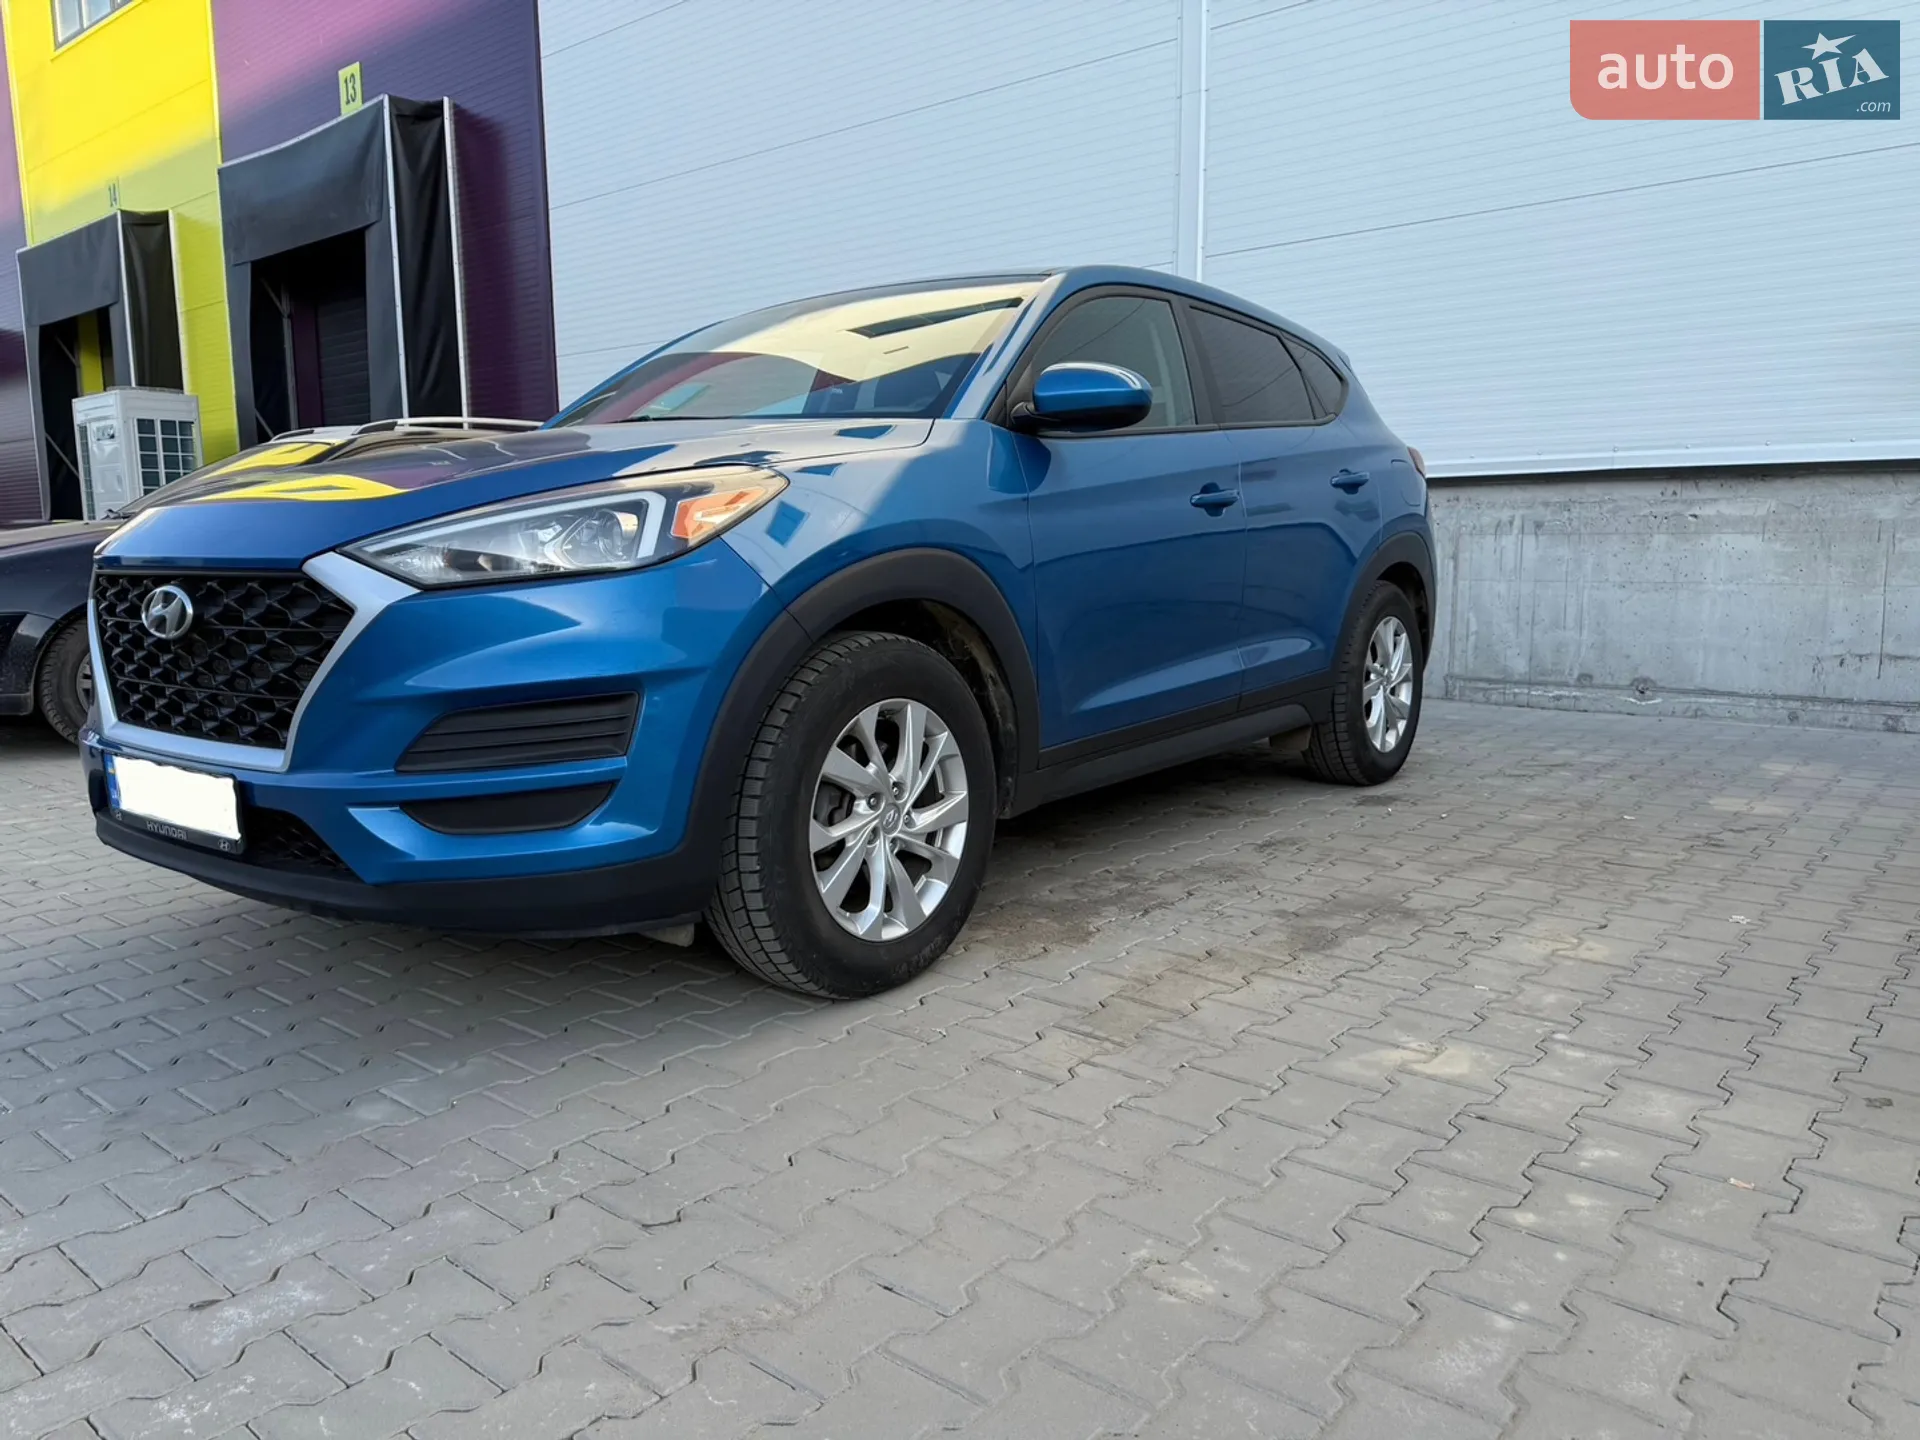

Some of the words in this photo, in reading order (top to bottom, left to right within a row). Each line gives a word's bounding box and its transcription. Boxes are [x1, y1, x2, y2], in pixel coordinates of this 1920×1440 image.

[343, 72, 357, 106] 13
[107, 182, 118, 208] 14
[146, 820, 189, 841] HYUNDAI
